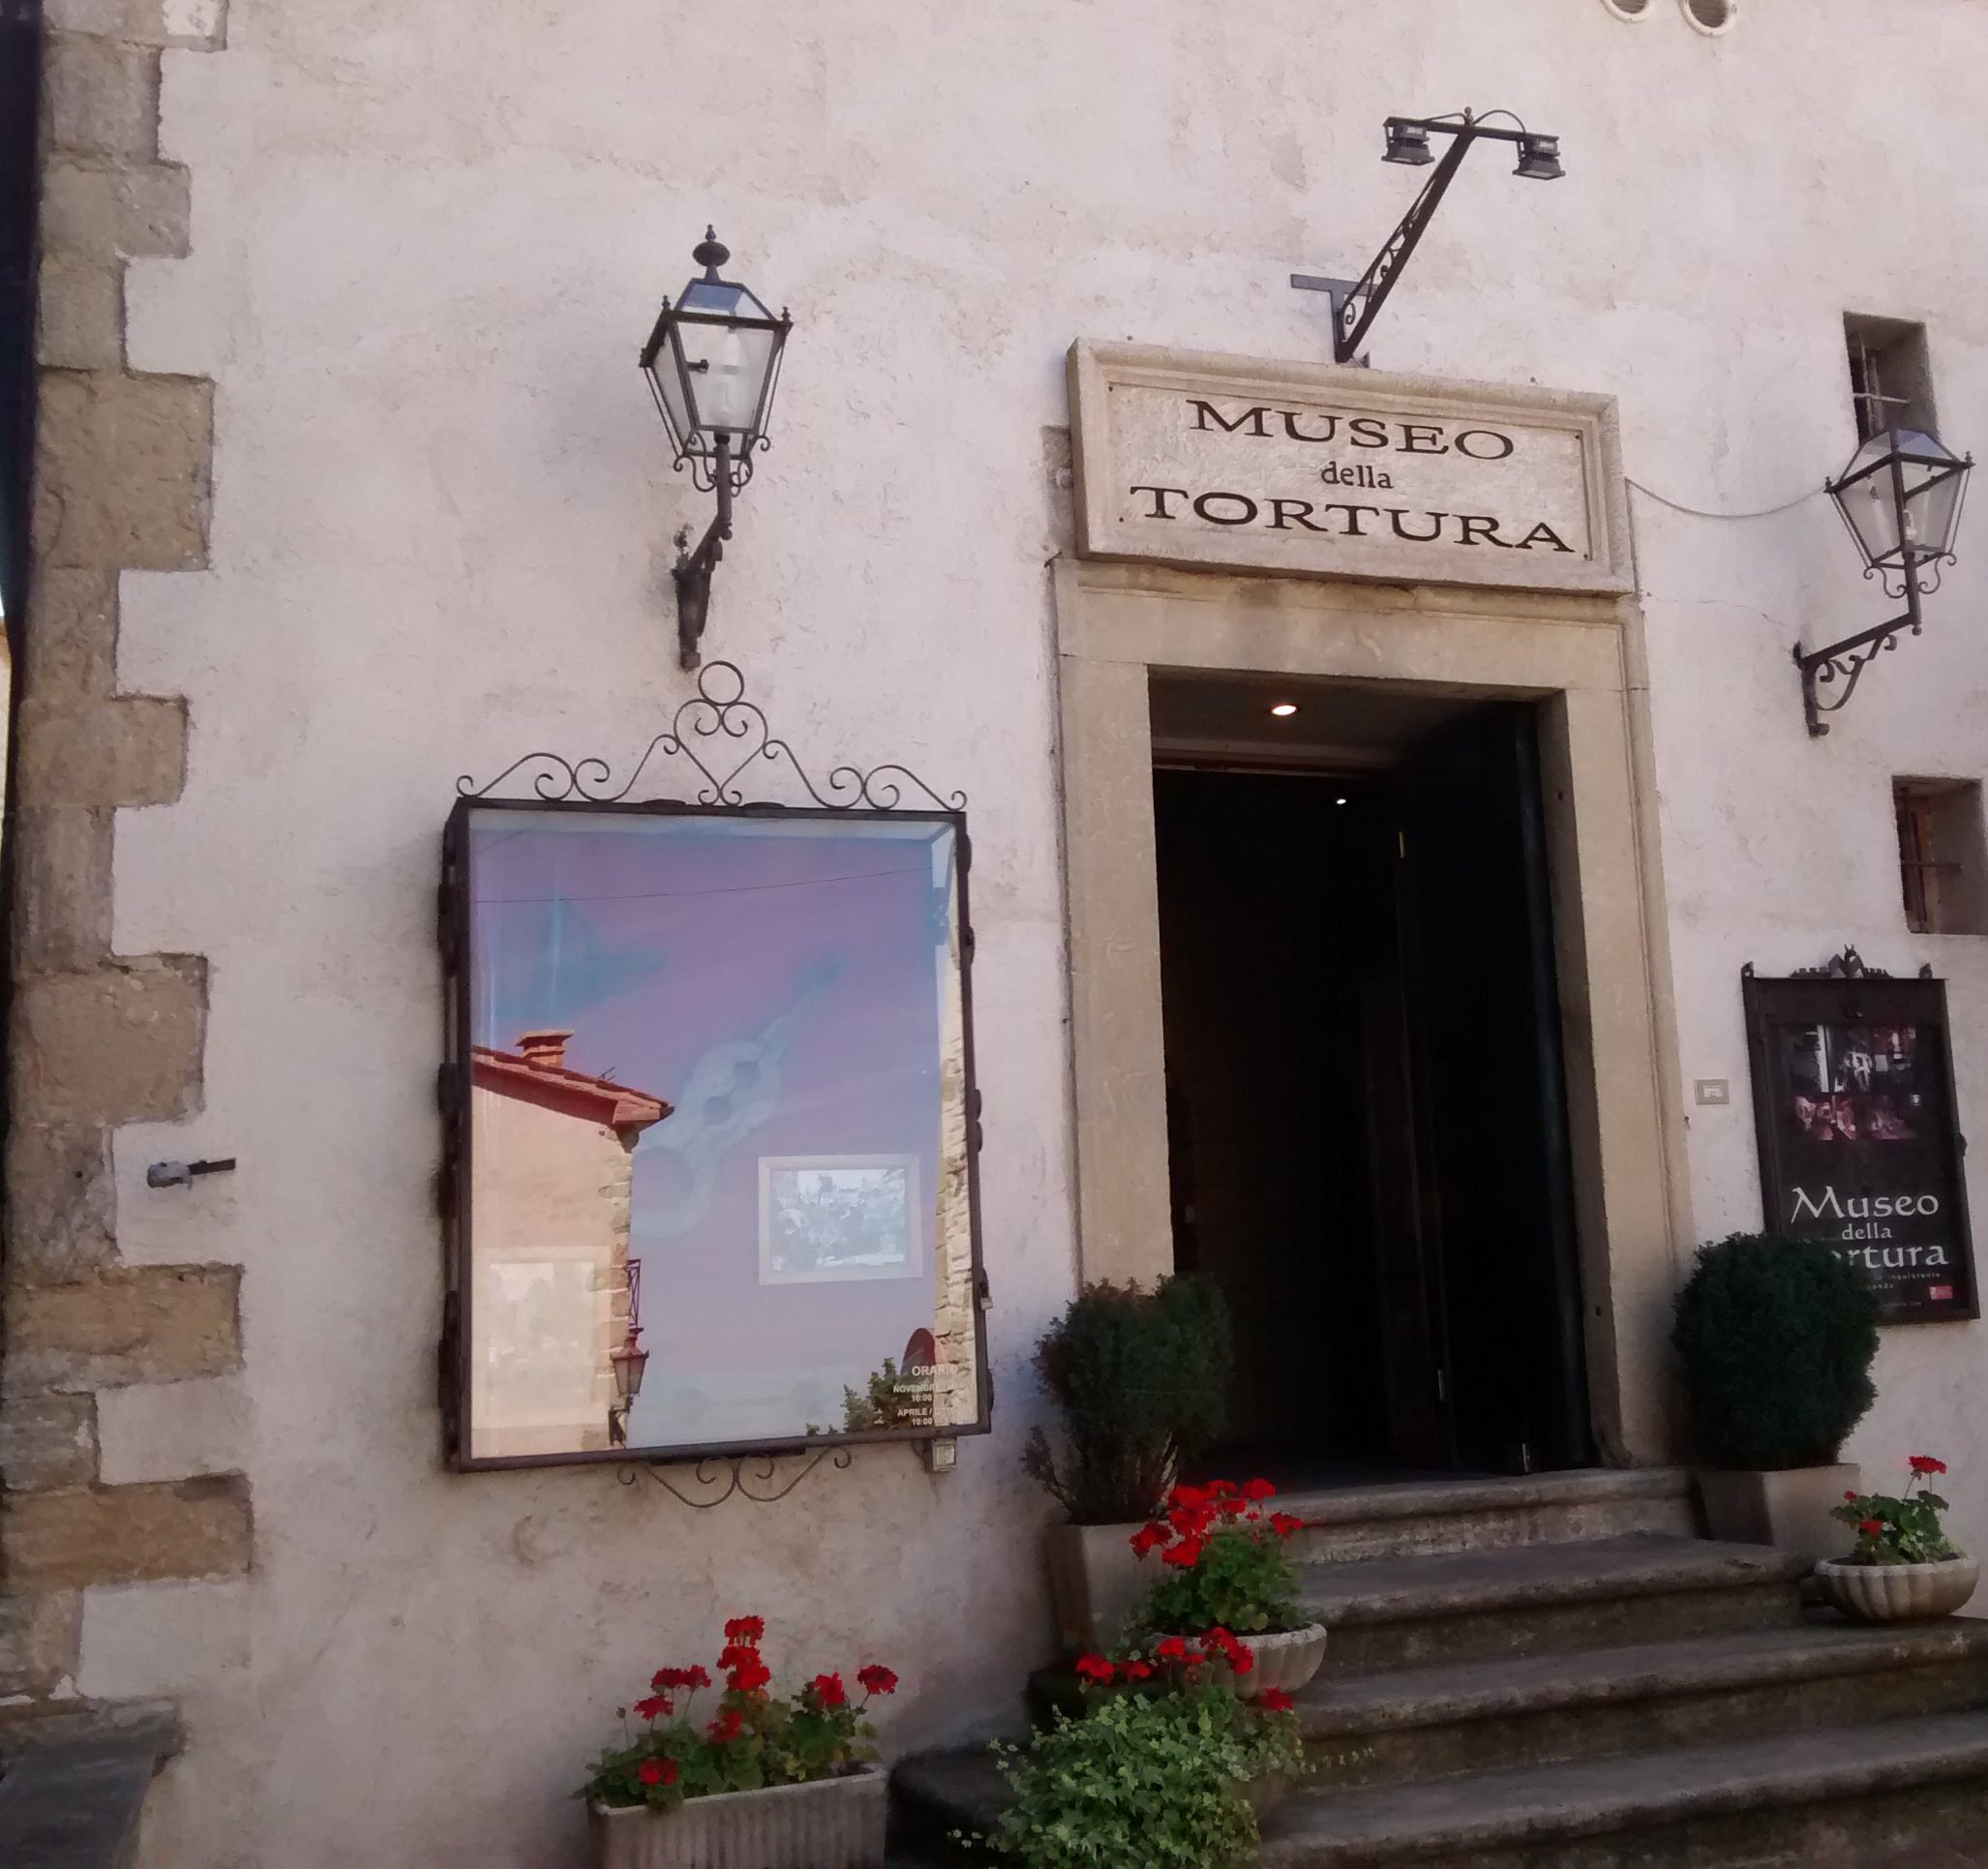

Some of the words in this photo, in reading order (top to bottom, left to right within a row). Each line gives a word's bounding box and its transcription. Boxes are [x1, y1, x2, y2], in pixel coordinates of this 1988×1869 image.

[1186, 399, 1515, 460] MUSEO
[1321, 461, 1394, 490] della
[1130, 486, 1577, 554] TORTURA
[1791, 1186, 1939, 1223] Museo
[1842, 1222, 1893, 1241] della
[1831, 1246, 1950, 1270] rtura
[912, 1365, 958, 1376] ORARIO
[897, 1408, 927, 1418] APRILE
